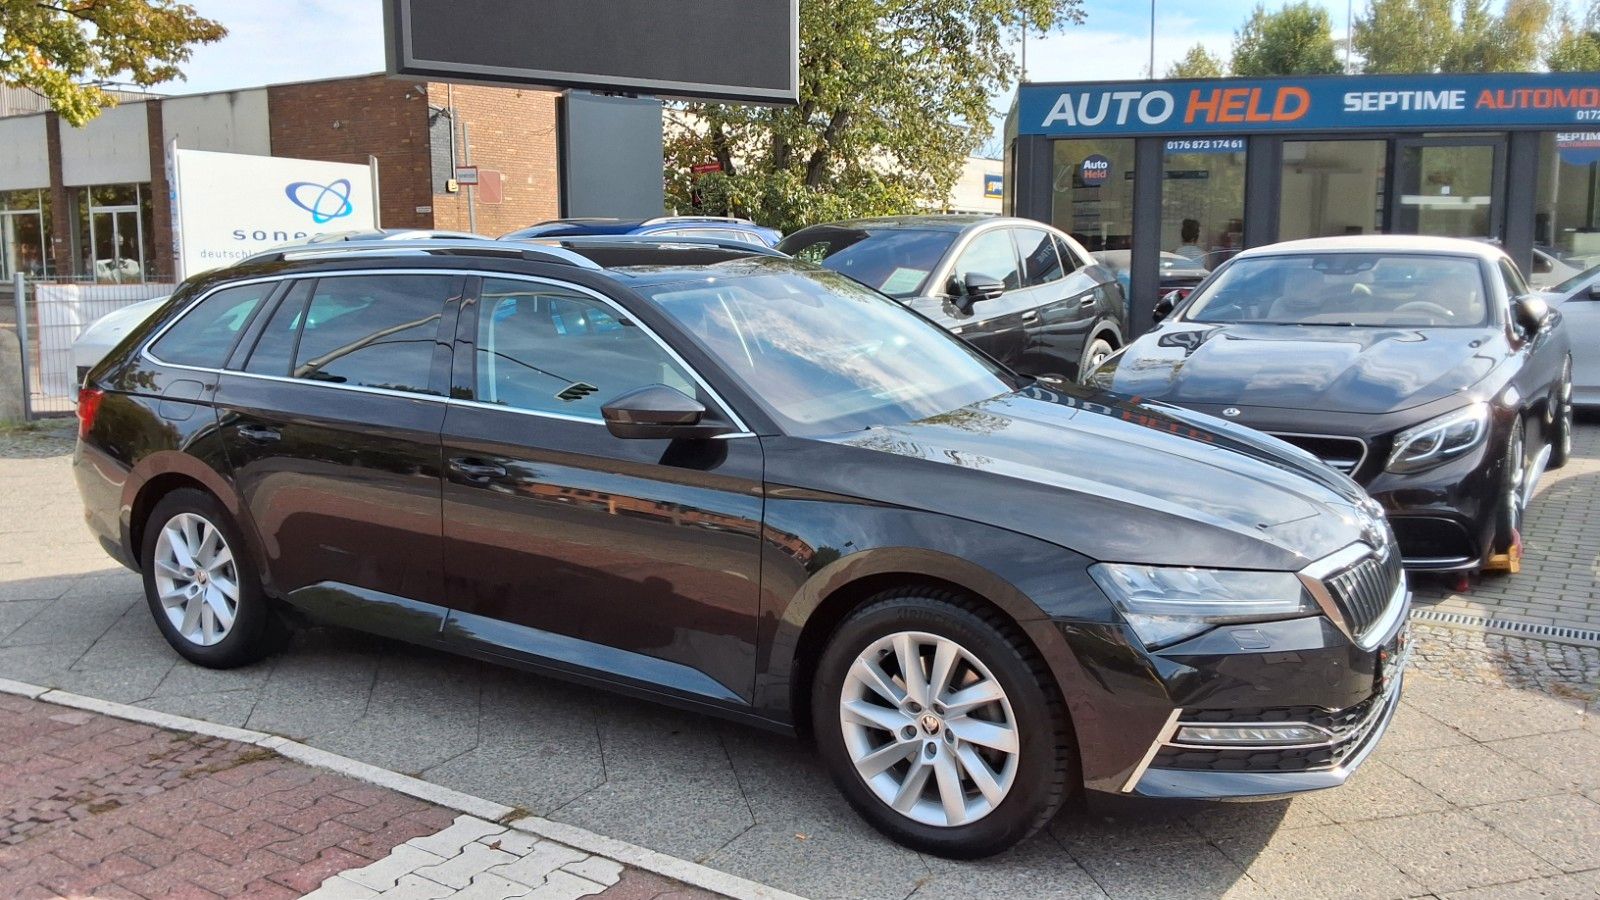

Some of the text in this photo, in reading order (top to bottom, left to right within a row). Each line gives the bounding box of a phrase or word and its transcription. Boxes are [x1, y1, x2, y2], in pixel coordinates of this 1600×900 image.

[1343, 88, 1600, 112] SEPTIME AUTOMO
[1041, 86, 1311, 127] AUTO HELD
[1557, 132, 1600, 142] SEPTIM
[1167, 140, 1243, 150] 0176 873 174 61
[1083, 160, 1108, 169] Auto
[1084, 170, 1107, 179] Held
[233, 229, 308, 241] sone
[200, 249, 252, 259] deutschl
